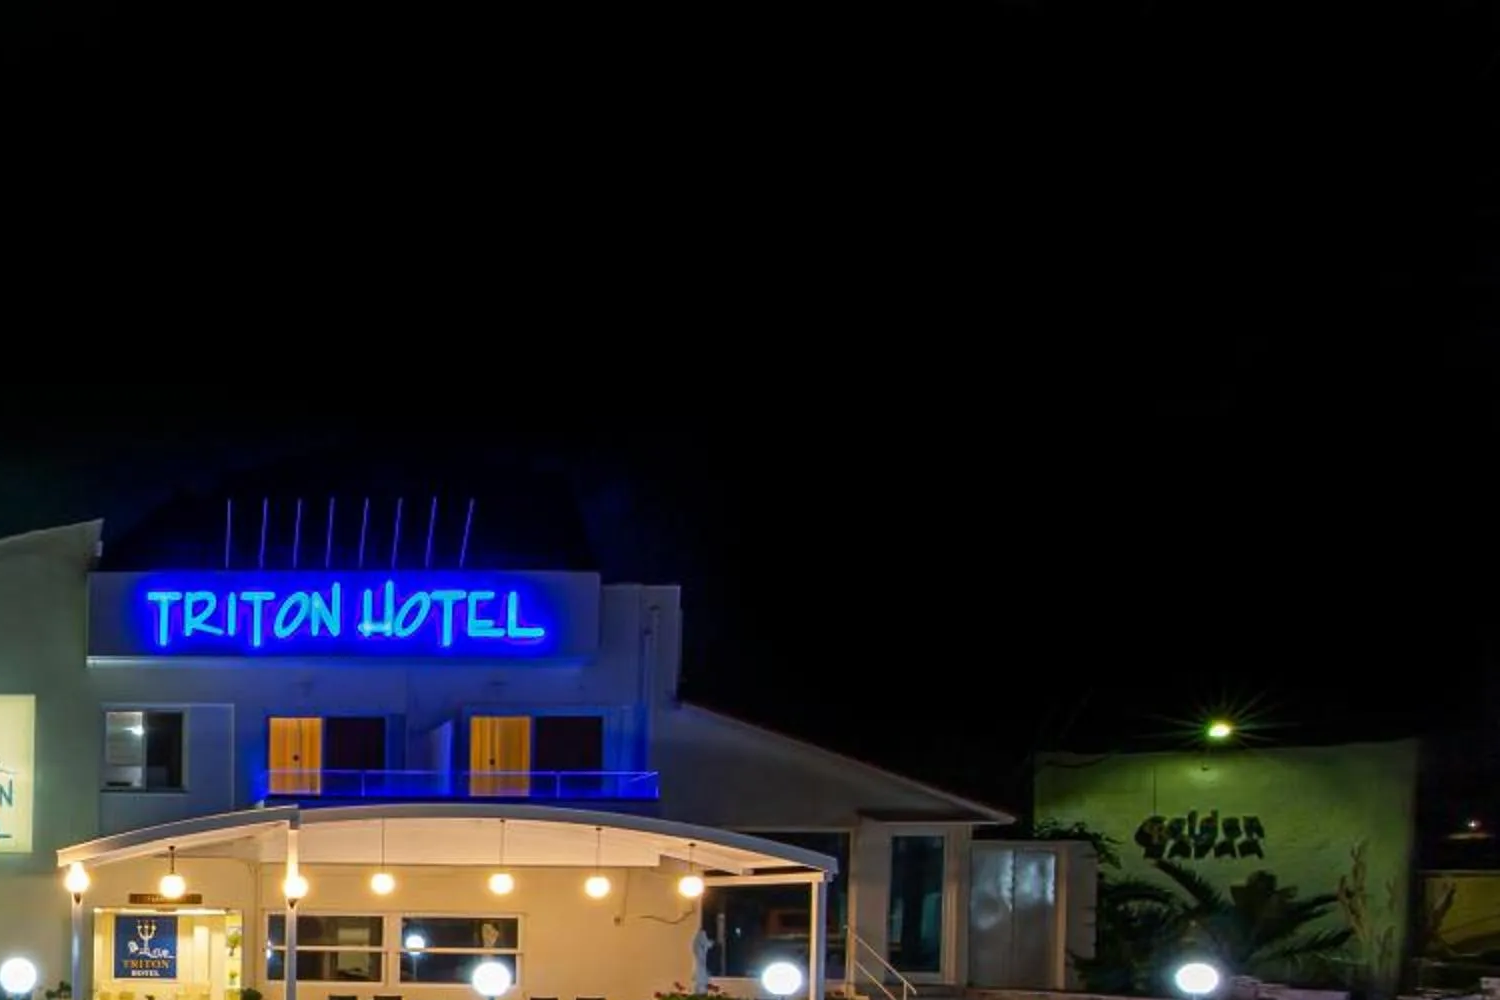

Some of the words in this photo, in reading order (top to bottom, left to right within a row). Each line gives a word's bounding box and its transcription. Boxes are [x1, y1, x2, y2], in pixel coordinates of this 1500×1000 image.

[147, 581, 341, 647] TRITON
[357, 579, 545, 647] HOTEL
[122, 959, 170, 969] TRITON
